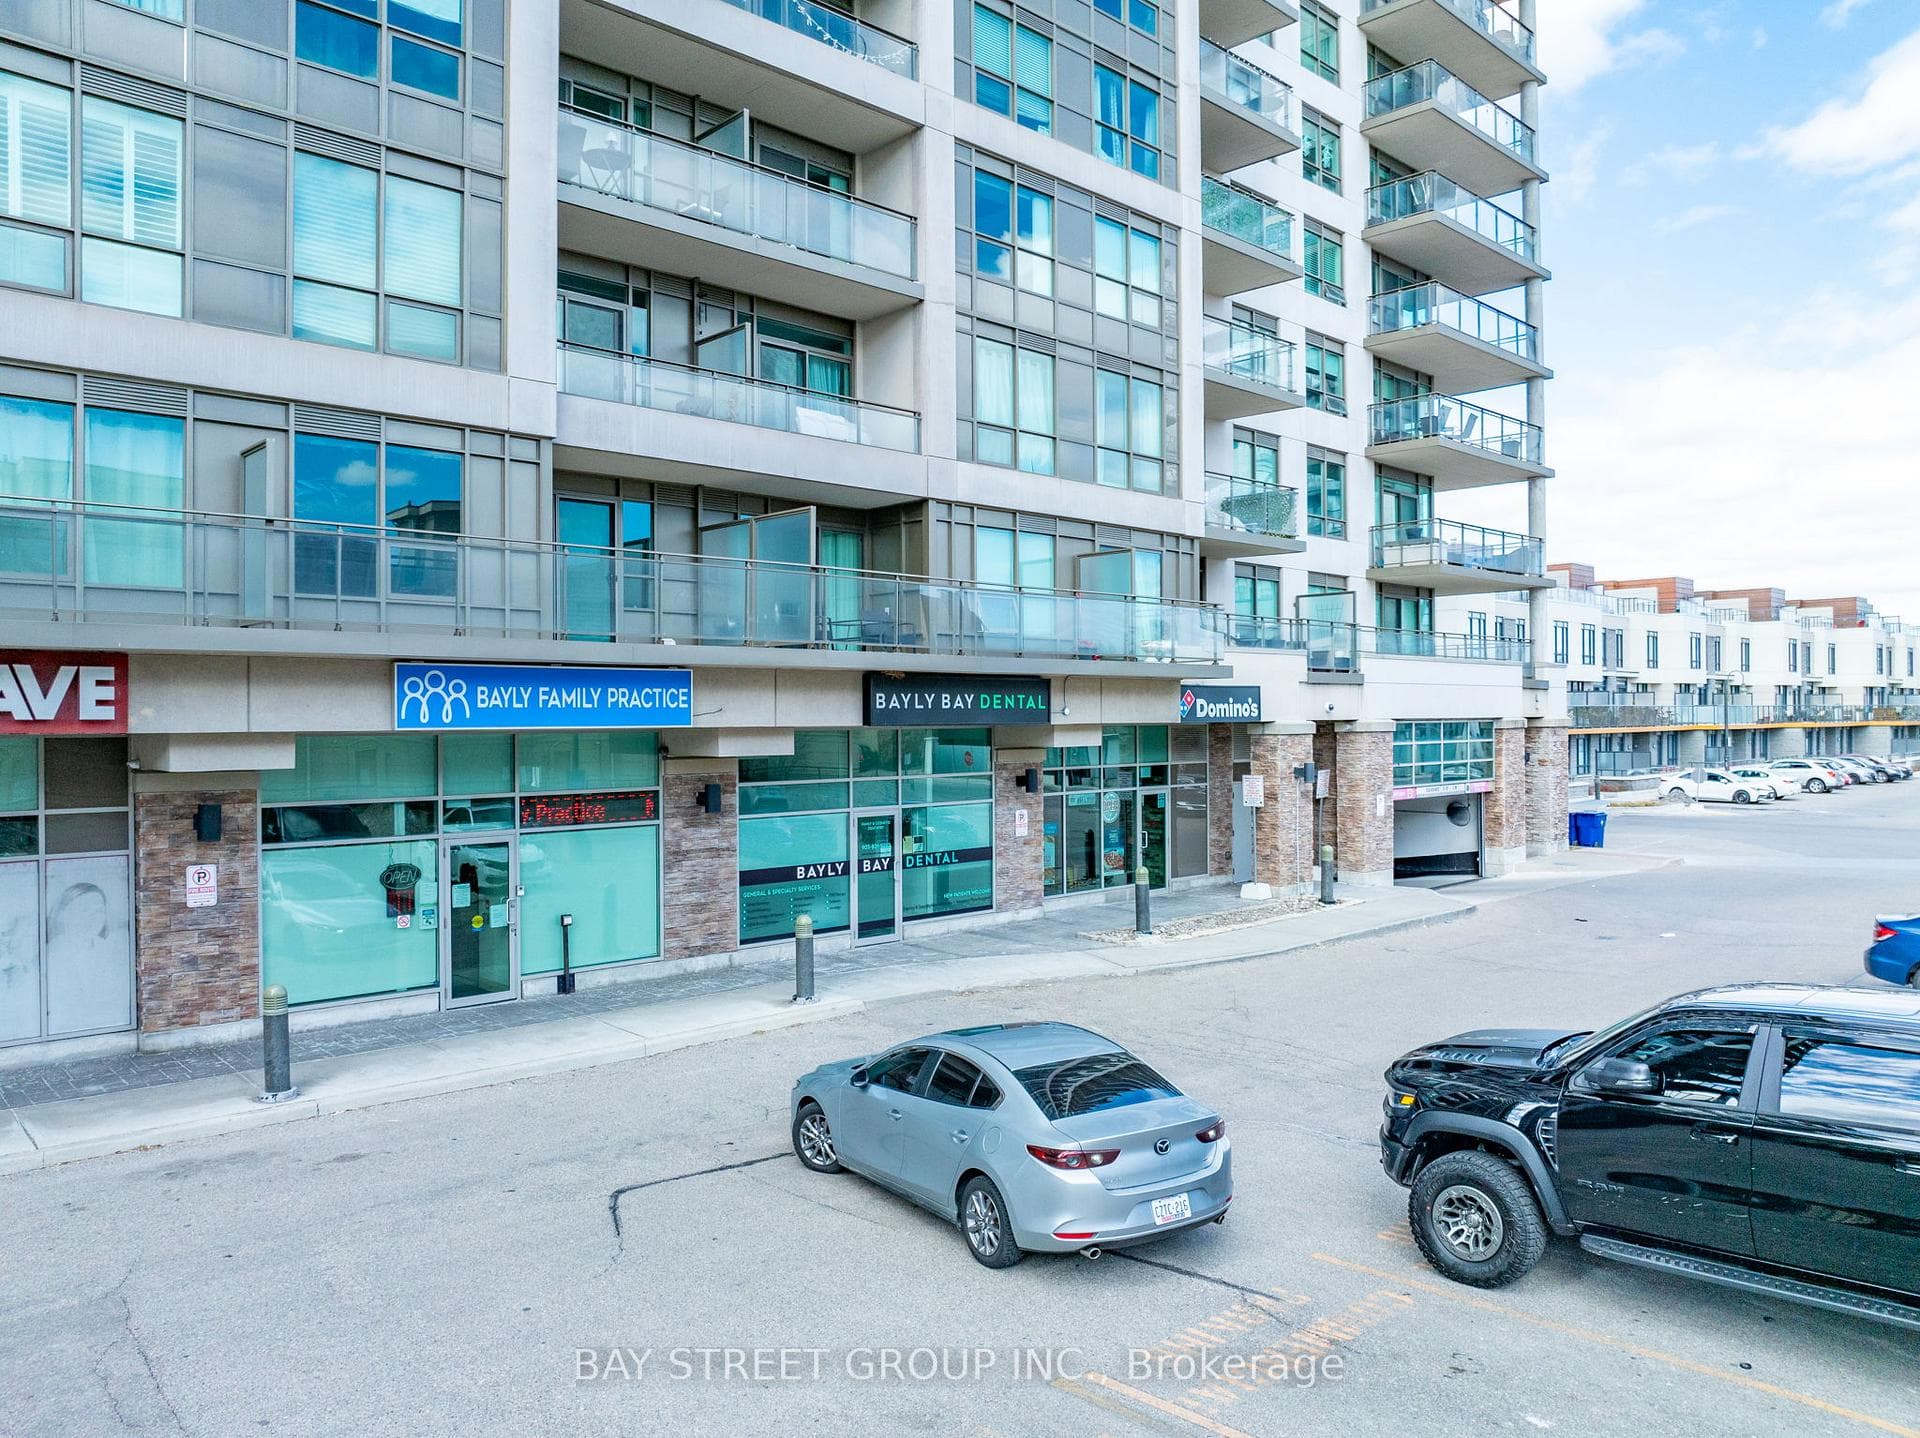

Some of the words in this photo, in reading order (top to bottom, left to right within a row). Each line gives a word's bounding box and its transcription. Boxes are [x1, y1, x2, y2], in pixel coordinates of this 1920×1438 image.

[477, 686, 533, 708] BAYLY
[539, 687, 601, 708] FAMILY
[608, 688, 688, 708] PRACTICE
[875, 693, 935, 709] BAYLY
[941, 693, 974, 709] BAY
[980, 694, 1046, 709] DENTAL
[1196, 697, 1259, 718] Domino's
[797, 862, 844, 879] BAYLY
[863, 858, 890, 872] BAY
[906, 852, 958, 867] DENTAL
[384, 870, 418, 884] OPEN
